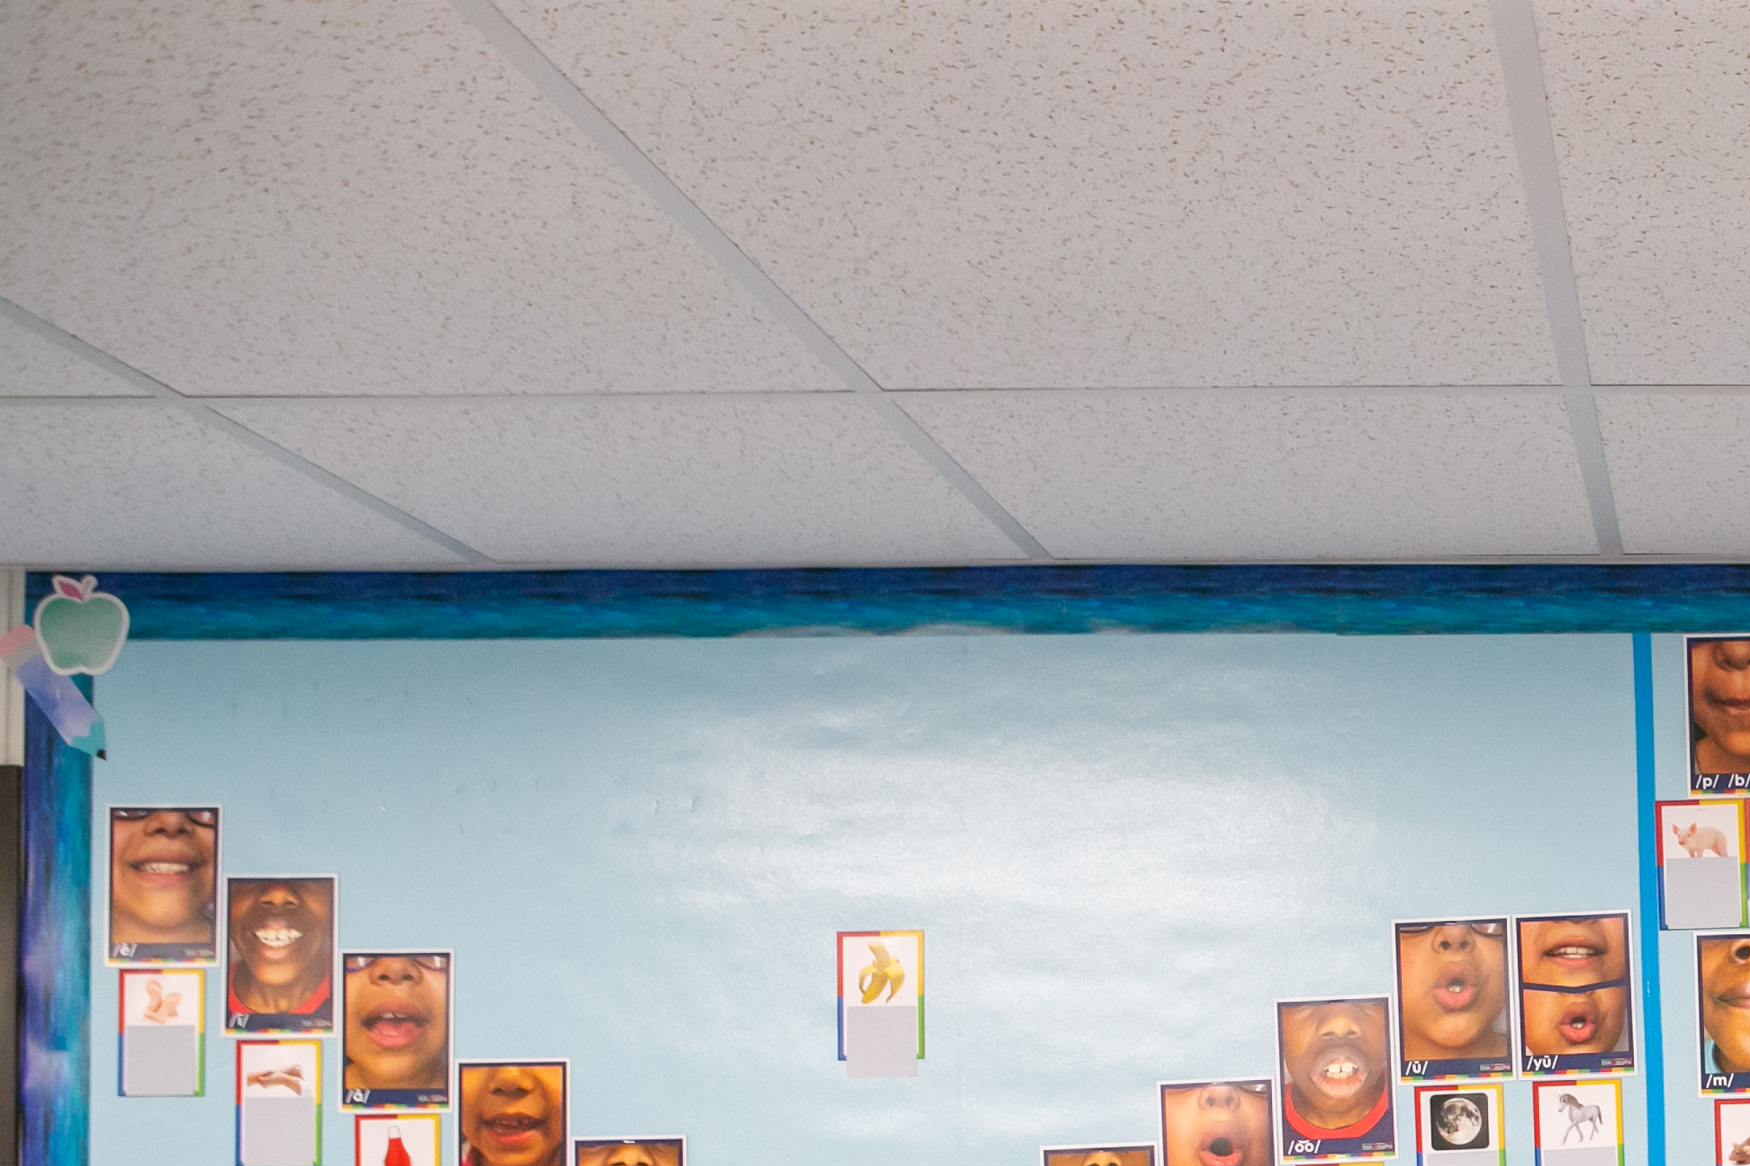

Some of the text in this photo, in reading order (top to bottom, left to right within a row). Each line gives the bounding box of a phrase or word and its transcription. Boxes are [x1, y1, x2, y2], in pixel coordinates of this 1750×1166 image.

[1695, 774, 1750, 789] /p/ /b/
[1706, 1073, 1734, 1088] /m/
